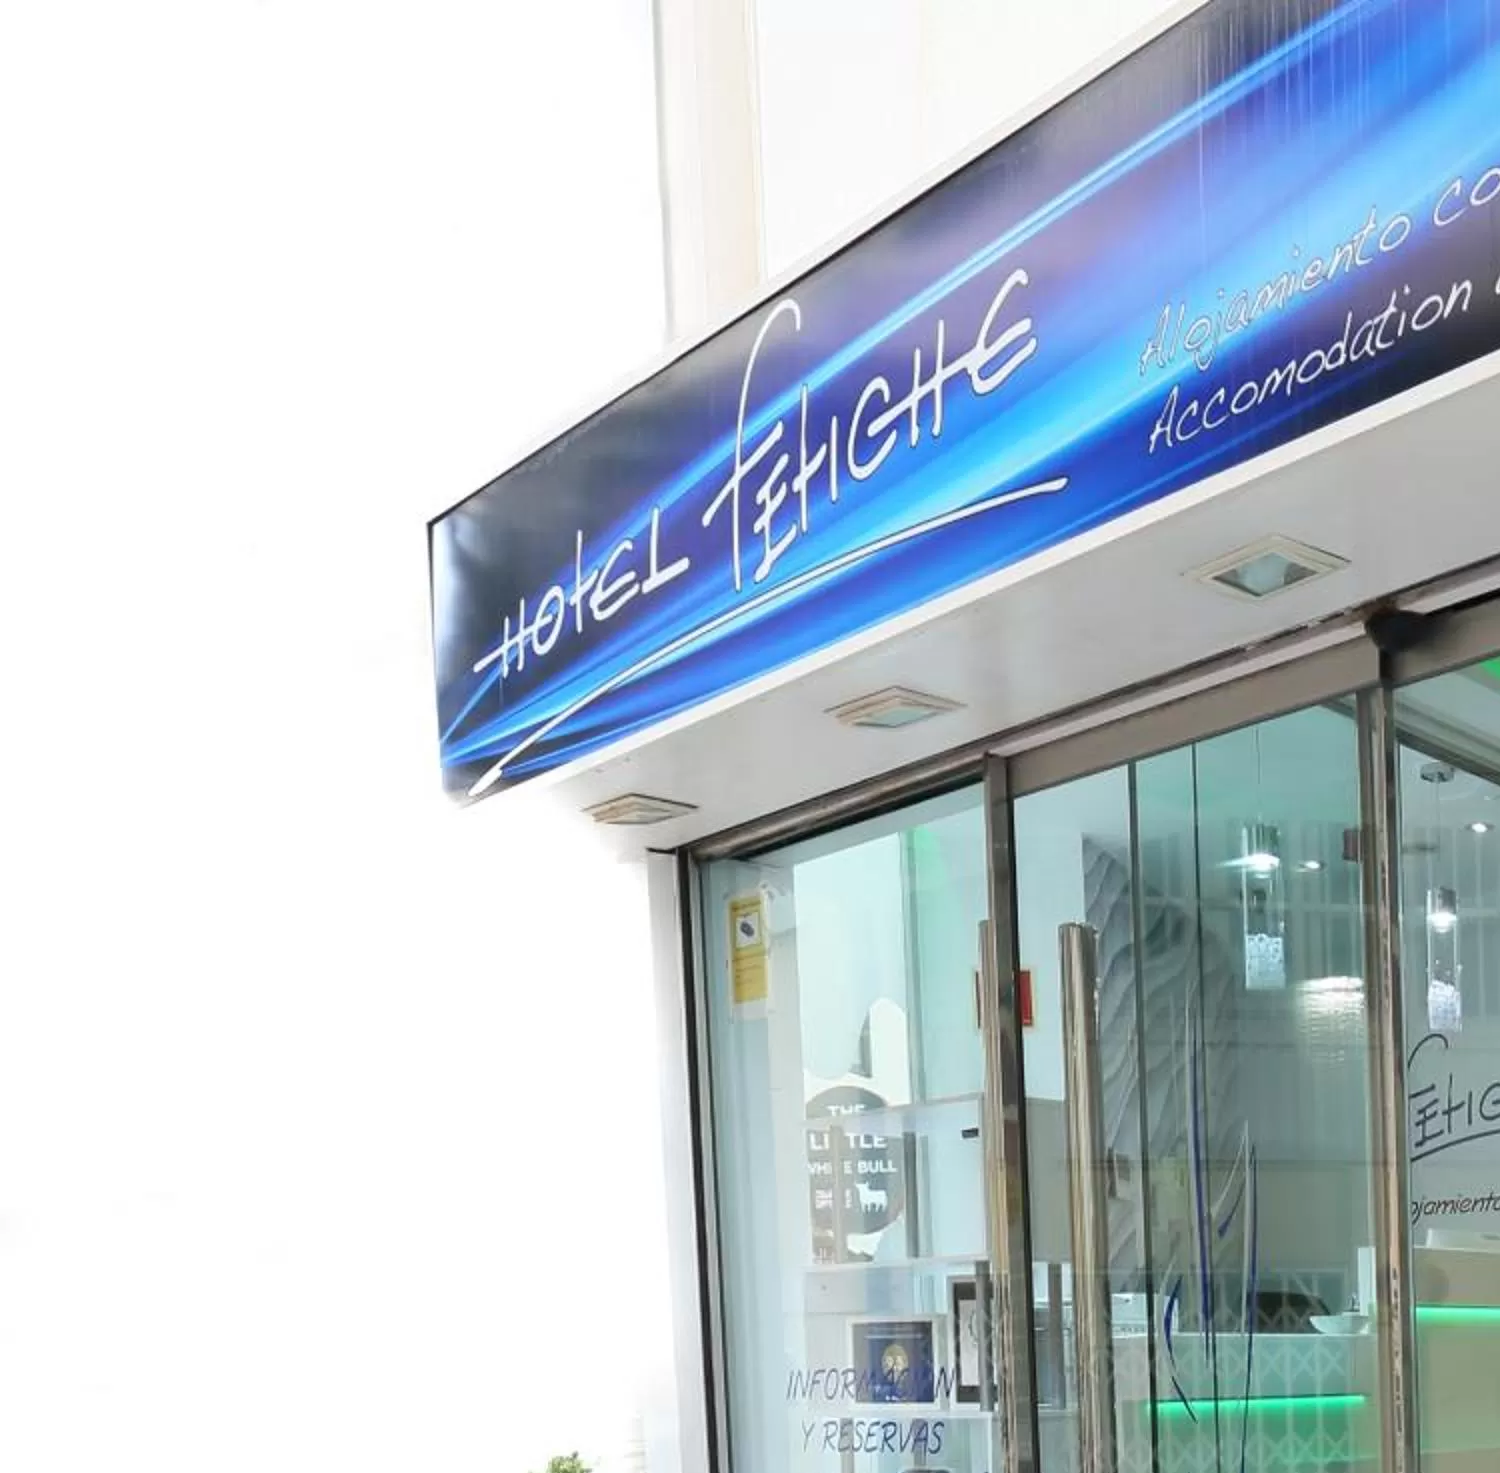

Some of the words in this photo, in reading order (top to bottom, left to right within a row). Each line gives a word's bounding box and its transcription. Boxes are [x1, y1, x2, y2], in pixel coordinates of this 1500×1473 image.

[1138, 204, 1411, 376] Alojamiento
[1148, 276, 1473, 454] Accomodation
[808, 1132, 888, 1150] LITLE
[857, 1159, 898, 1174] BULL
[801, 1418, 816, 1453] Y
[822, 1419, 945, 1455] RESERVAS
